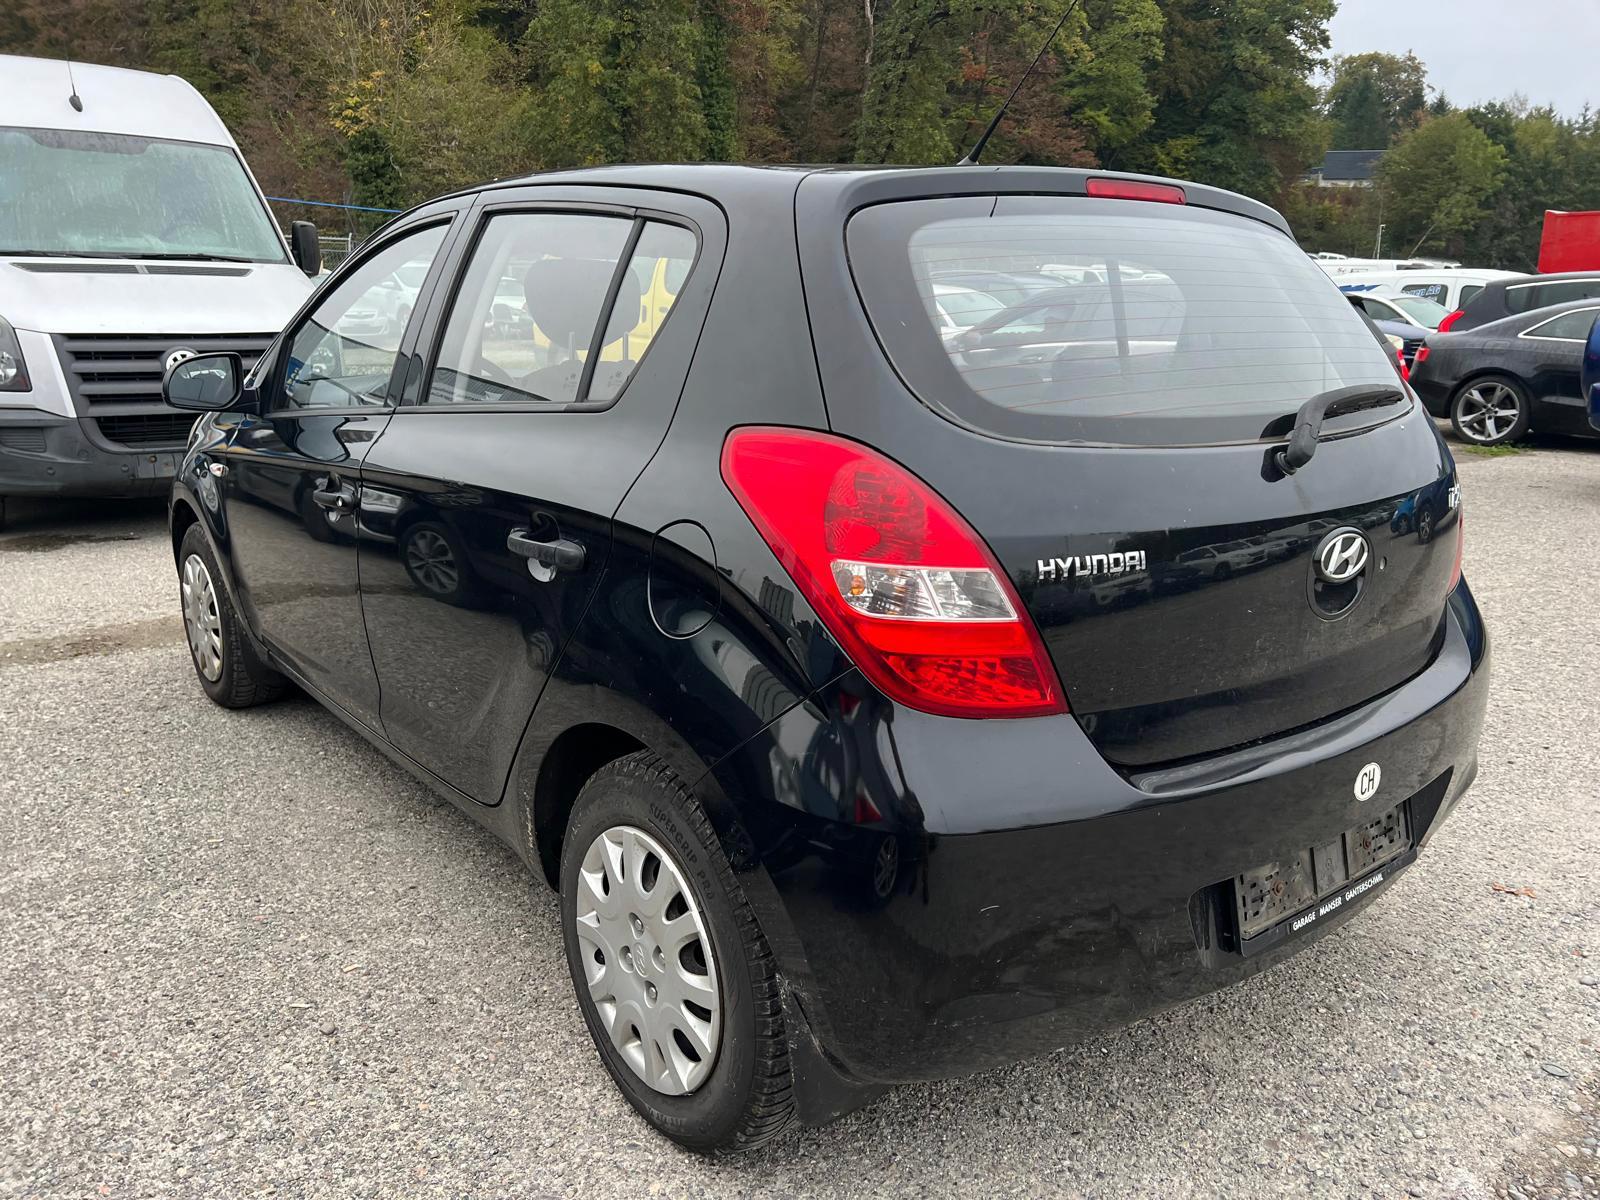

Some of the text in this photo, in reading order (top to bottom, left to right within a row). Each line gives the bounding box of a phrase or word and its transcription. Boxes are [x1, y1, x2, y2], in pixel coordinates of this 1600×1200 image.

[1037, 550, 1147, 580] HYUNDAI
[1360, 767, 1376, 796] CH
[648, 803, 714, 900] SUPERGRIP PRO
[1292, 911, 1316, 931] GARAGE
[1319, 896, 1343, 917] MANSER
